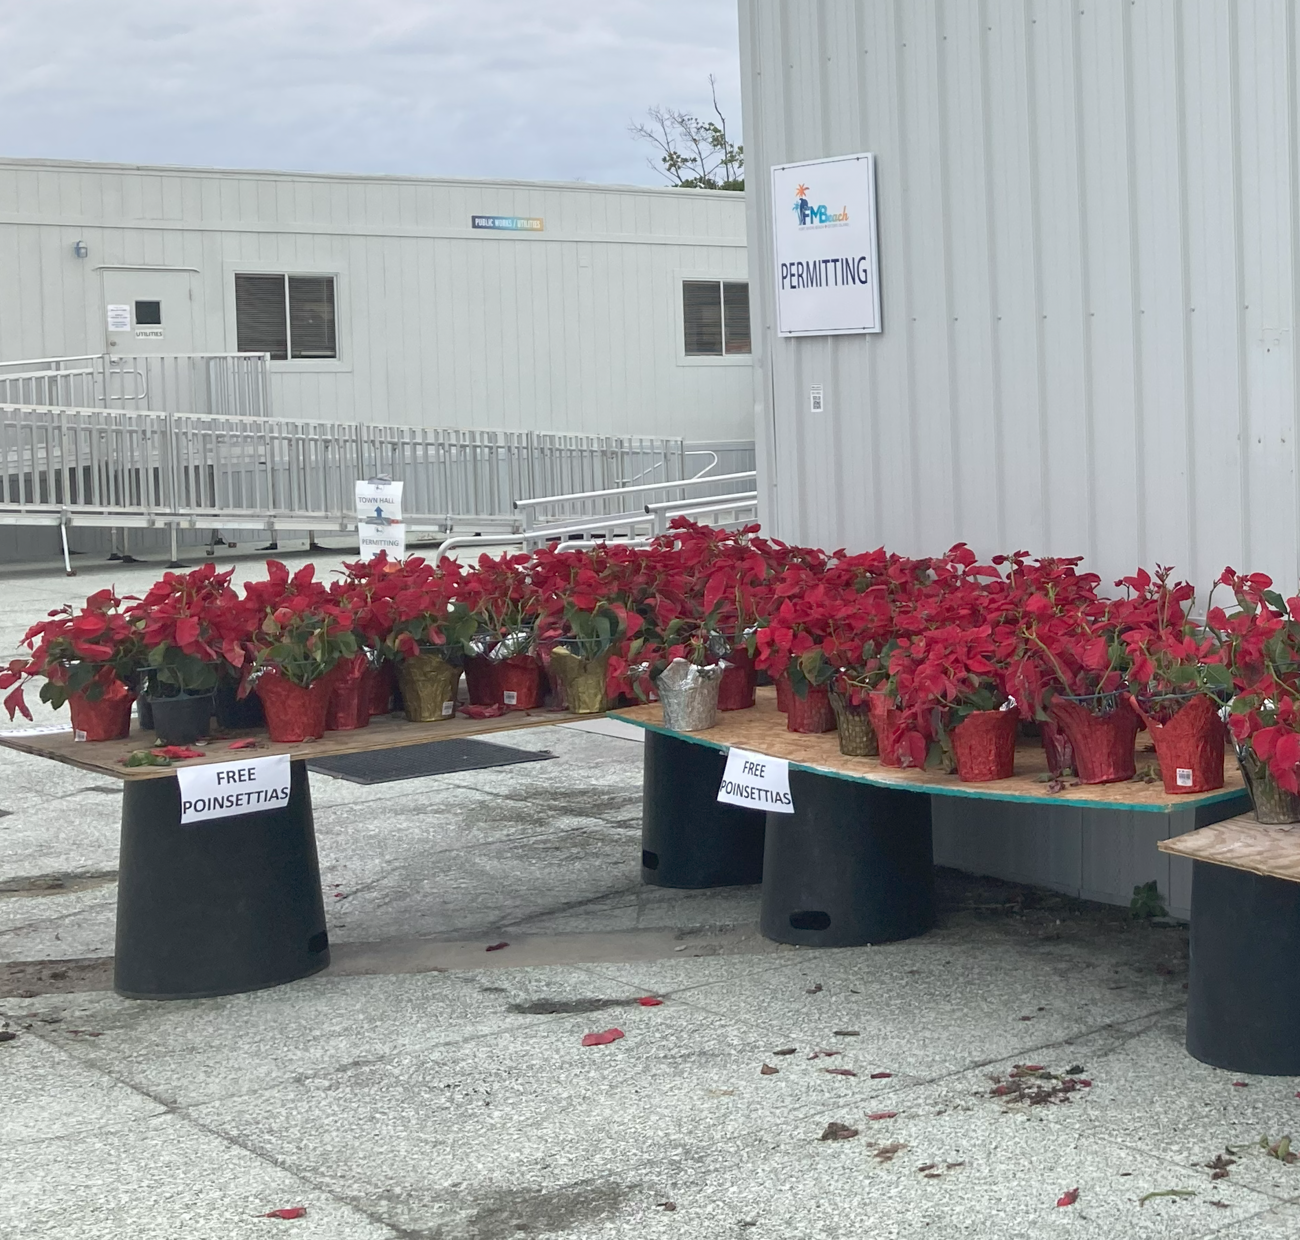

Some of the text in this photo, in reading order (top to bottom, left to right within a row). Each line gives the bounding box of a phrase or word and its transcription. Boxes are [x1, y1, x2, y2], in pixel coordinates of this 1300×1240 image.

[475, 218, 493, 227] PUBLIC
[495, 218, 512, 227] WORKS
[518, 219, 541, 228] UTILITIES
[781, 256, 868, 290] PERMITTING
[362, 538, 399, 546] PERMITTING
[216, 767, 256, 785] FREE
[742, 761, 766, 778] FREE
[183, 787, 289, 814] POINSETTIAS
[720, 780, 791, 805] POINSETTIAS
